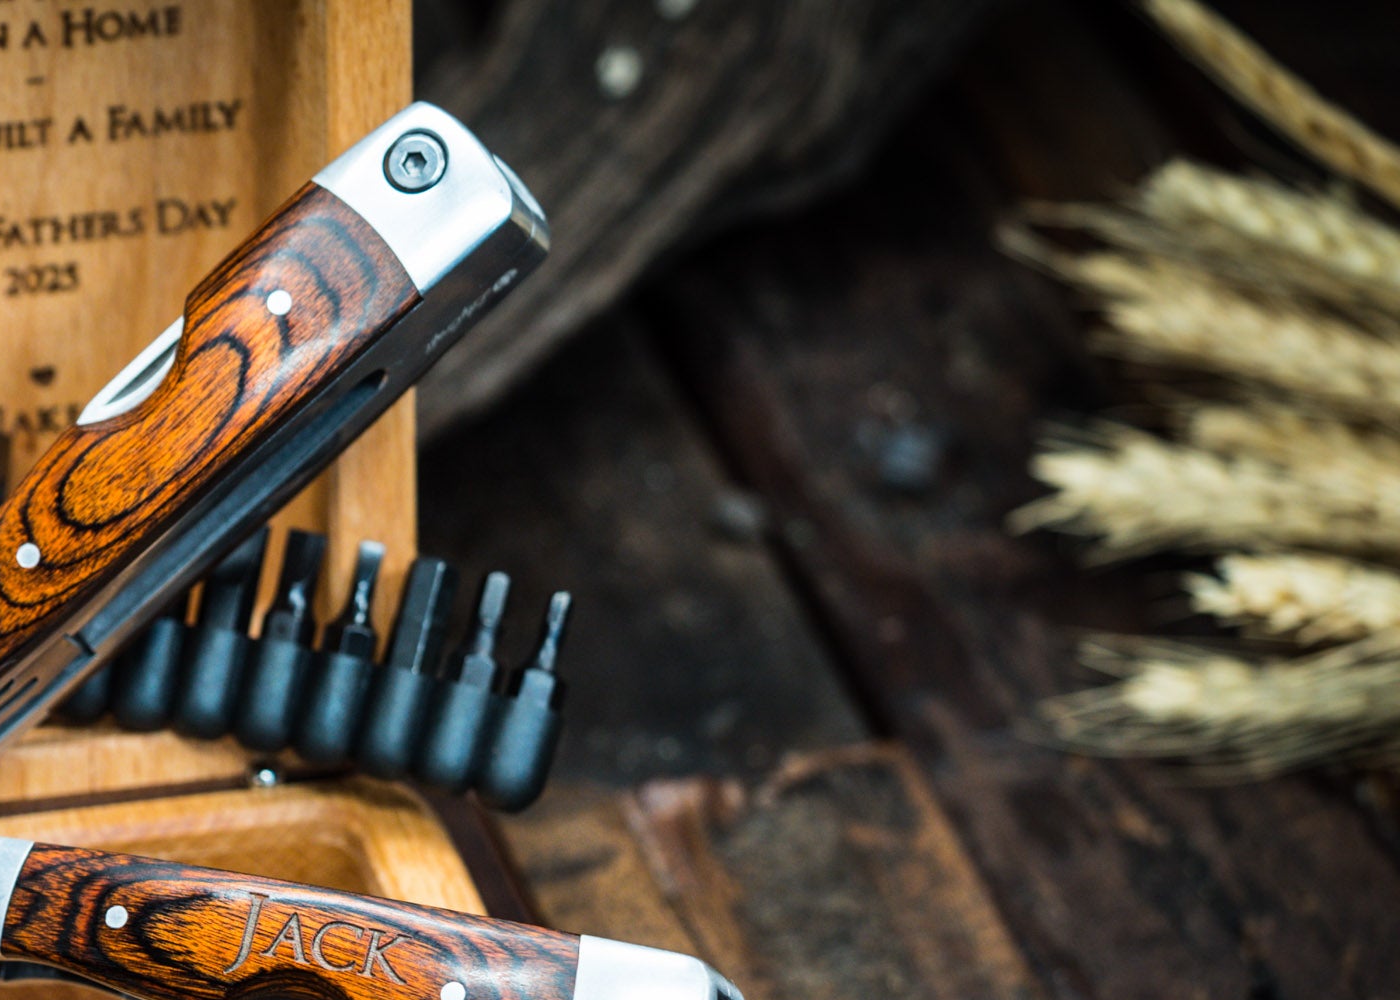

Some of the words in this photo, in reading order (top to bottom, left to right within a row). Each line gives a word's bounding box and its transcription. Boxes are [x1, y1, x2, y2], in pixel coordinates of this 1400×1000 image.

[22, 19, 48, 48] A
[61, 6, 183, 48] HOME
[67, 115, 93, 144] A
[107, 99, 241, 142] FAMILY
[155, 198, 236, 237] DAY
[4, 262, 79, 297] 2025
[223, 891, 412, 985] JACK
